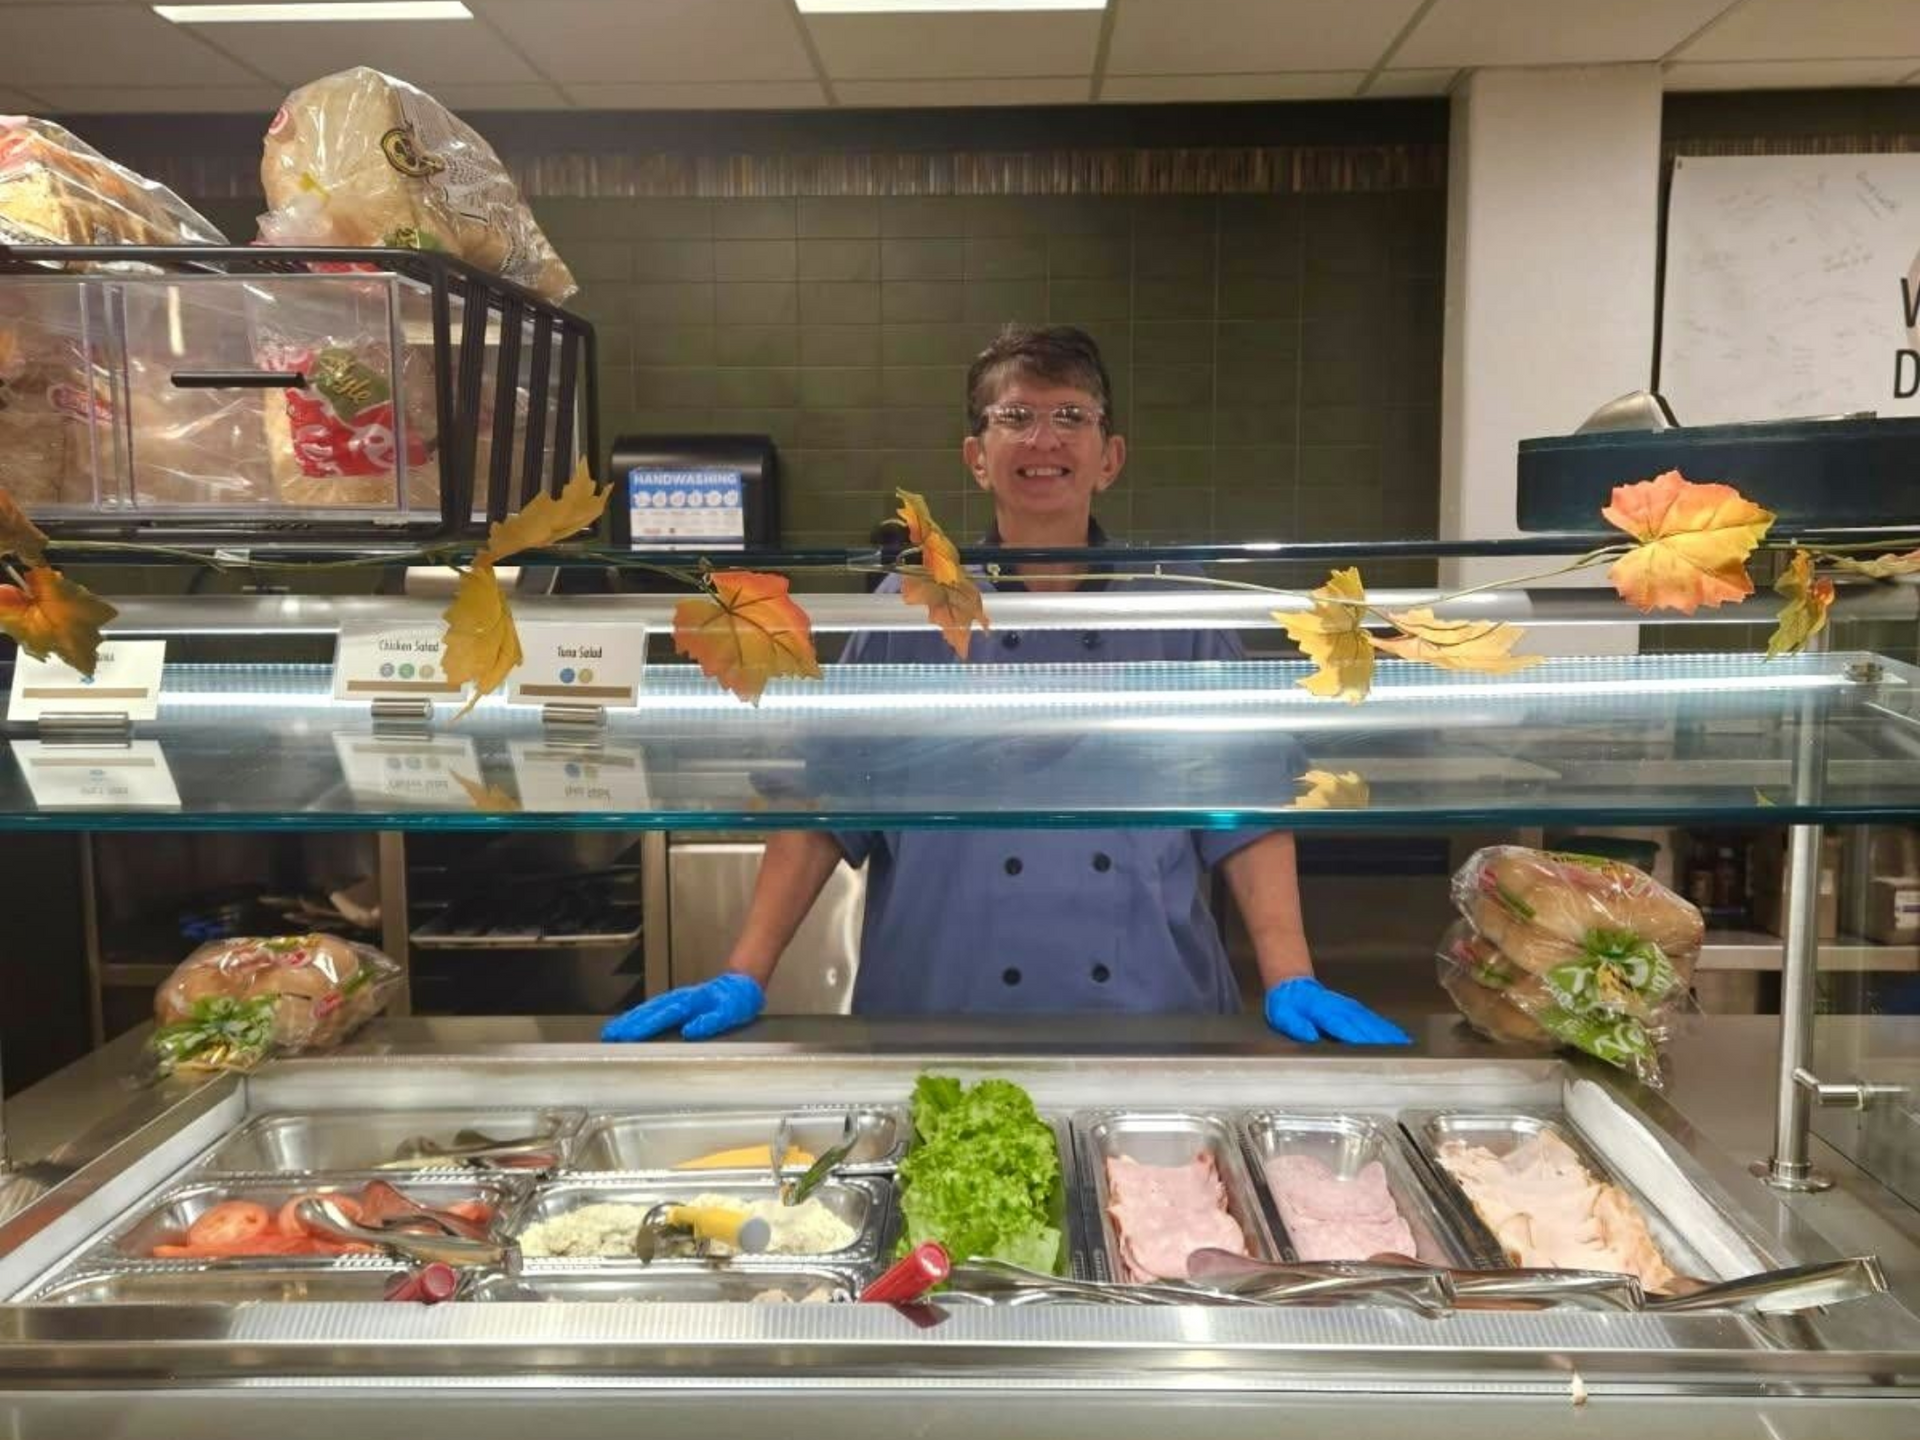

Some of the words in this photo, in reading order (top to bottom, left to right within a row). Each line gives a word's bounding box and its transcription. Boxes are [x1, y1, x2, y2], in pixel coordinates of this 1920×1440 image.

[633, 473, 738, 486] HANDWASHING
[378, 639, 412, 652] Chicken
[413, 639, 439, 652] Salad
[557, 645, 577, 658] Tuna
[579, 645, 603, 659] Salad
